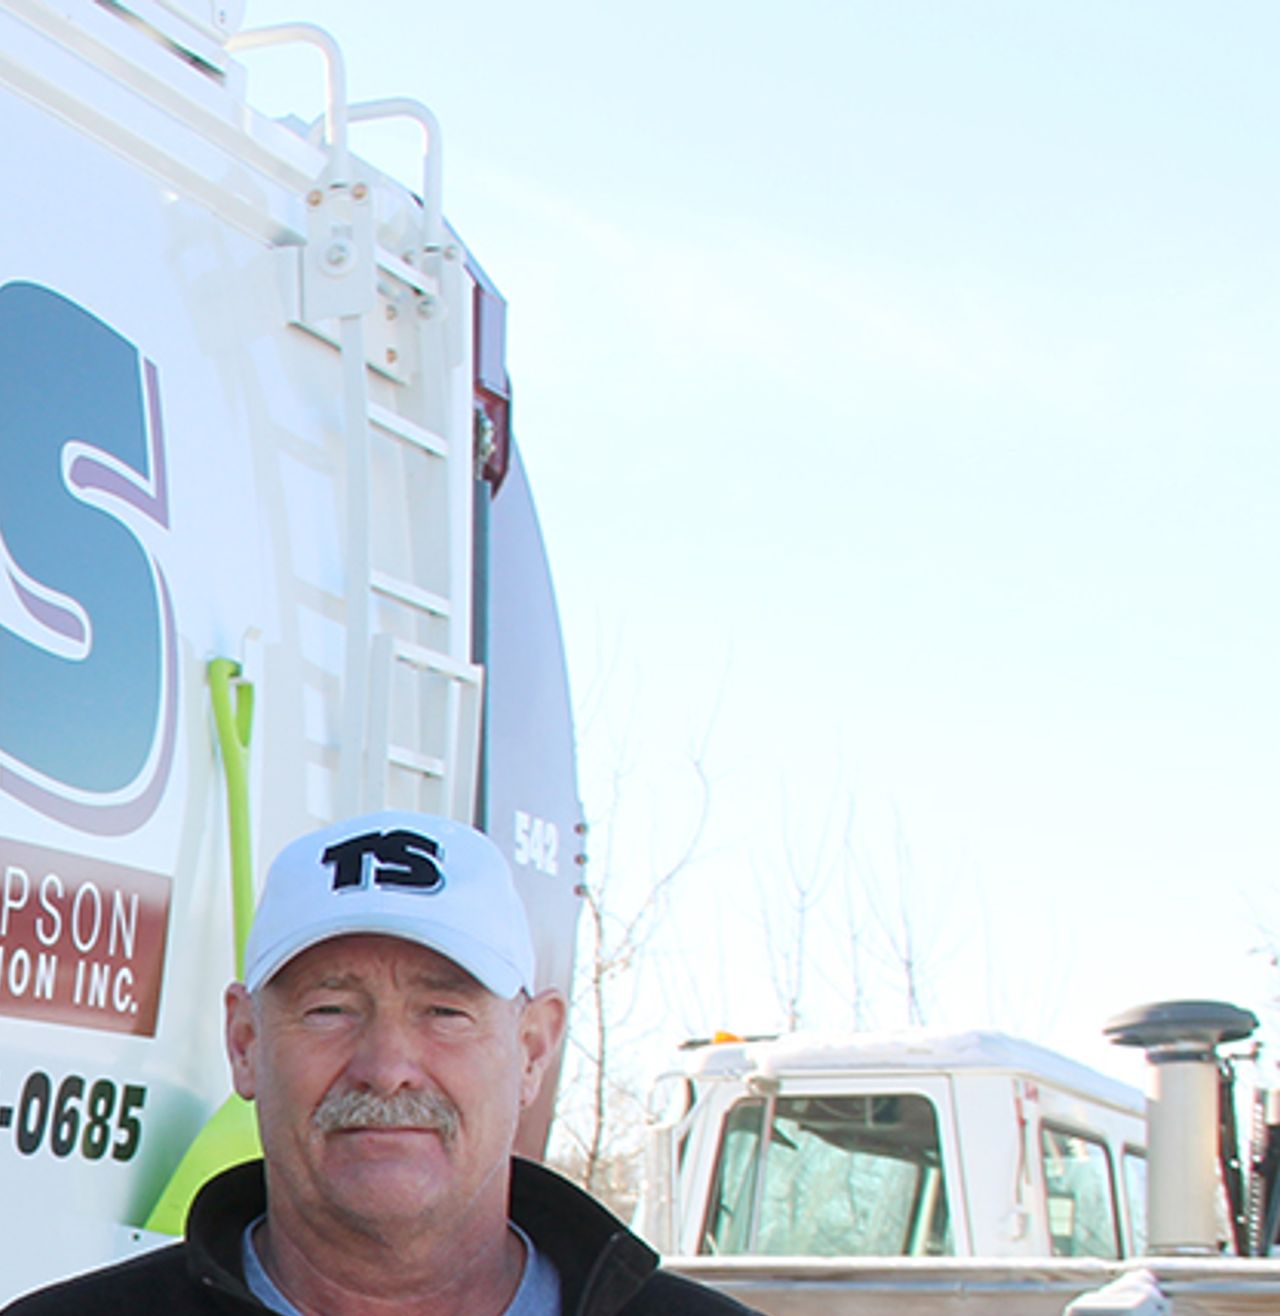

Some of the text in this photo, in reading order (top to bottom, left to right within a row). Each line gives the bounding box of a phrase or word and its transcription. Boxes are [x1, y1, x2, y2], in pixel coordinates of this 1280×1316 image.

[320, 829, 446, 896] TS
[512, 810, 558, 876] 542
[73, 961, 140, 1014] INC.
